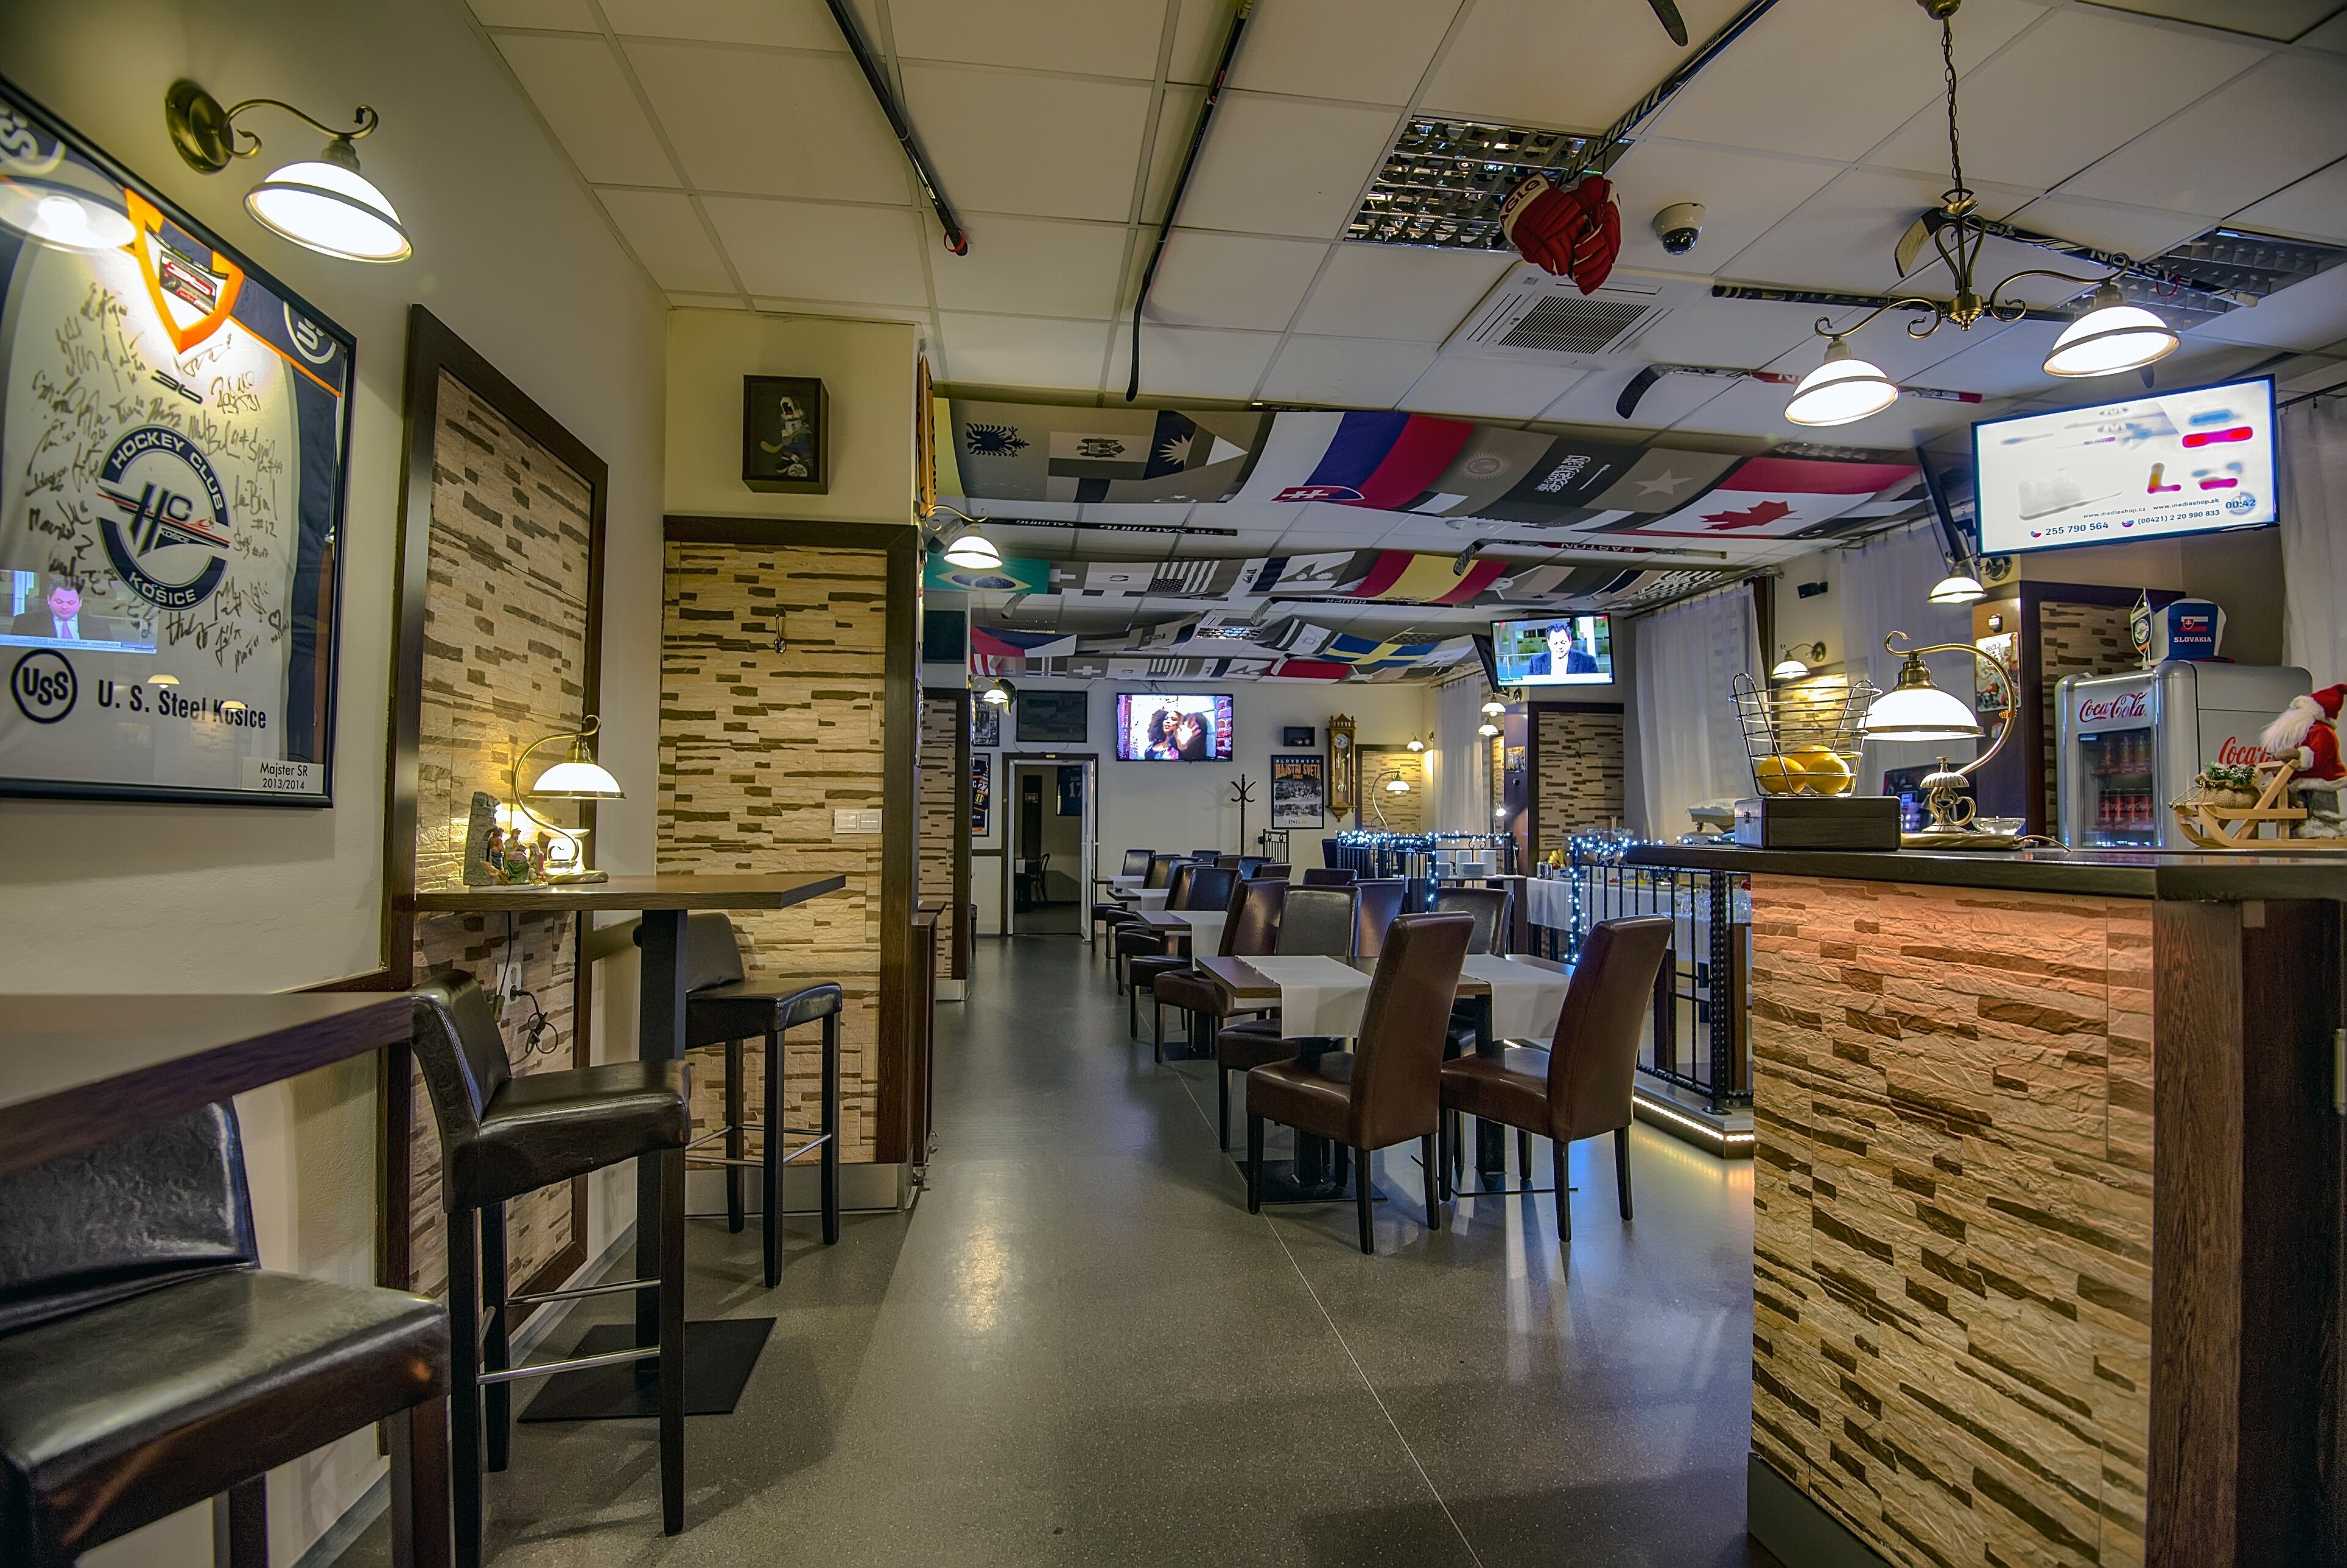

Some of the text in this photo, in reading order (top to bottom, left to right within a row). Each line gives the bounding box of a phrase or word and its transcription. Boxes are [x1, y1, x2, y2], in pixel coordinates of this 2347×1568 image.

[2089, 249, 2194, 287] EASTON
[111, 431, 186, 469] HOCKEY
[189, 451, 224, 510] CLUB
[2152, 497, 2256, 510] www.mediashop.sk 00:42
[2082, 507, 2146, 519] www.mediashop.cz
[2137, 515, 2168, 525] (00421)
[2188, 511, 2203, 519] 990
[2205, 509, 2220, 518] 833
[2045, 521, 2109, 536] 255 790 564
[1560, 541, 1635, 554] EASTON
[128, 571, 197, 606] KOŠICE
[22, 666, 70, 706] USS
[98, 679, 120, 709] U.
[130, 684, 150, 713] S.
[158, 689, 207, 721] Steel
[2079, 691, 2147, 723] Coca-Cola
[260, 762, 308, 778] Majster SR
[1275, 763, 1321, 780] MAJSTRI SVETA
[262, 778, 305, 790] 2013/2014
[978, 782, 988, 793] 27
